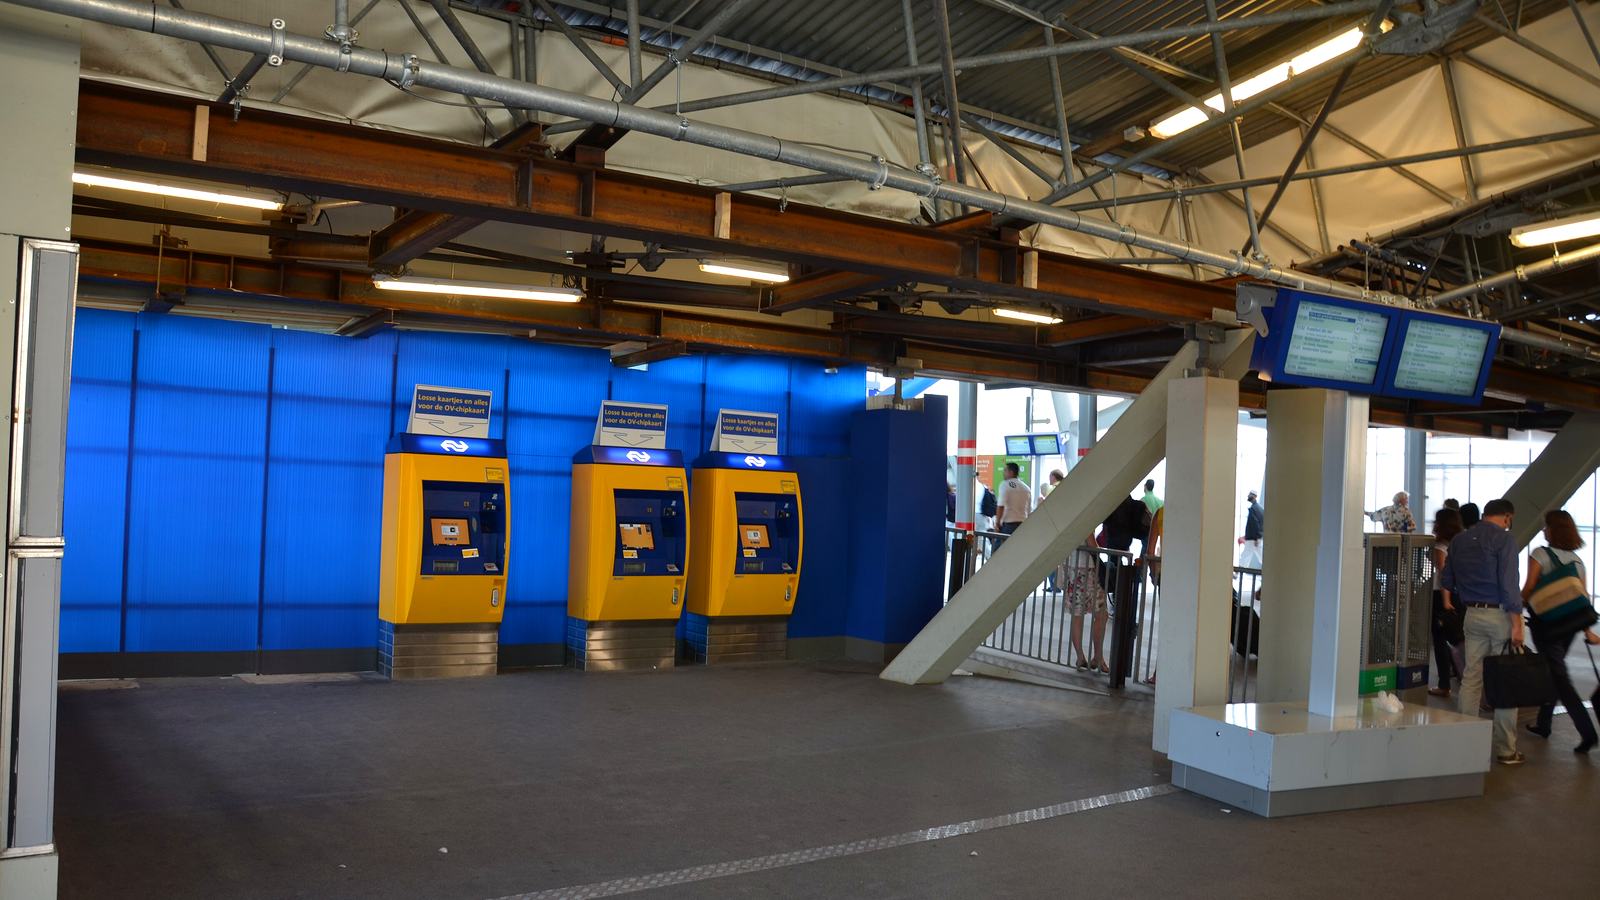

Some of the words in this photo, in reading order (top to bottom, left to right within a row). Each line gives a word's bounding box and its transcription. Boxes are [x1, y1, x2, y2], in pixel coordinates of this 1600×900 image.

[418, 394, 436, 402] Losse
[438, 395, 463, 405] kaartjes
[474, 399, 488, 407] alles
[444, 405, 485, 414] OV-chipkaart
[621, 410, 643, 419] kaartjes
[627, 418, 662, 427] OV-chipkaart
